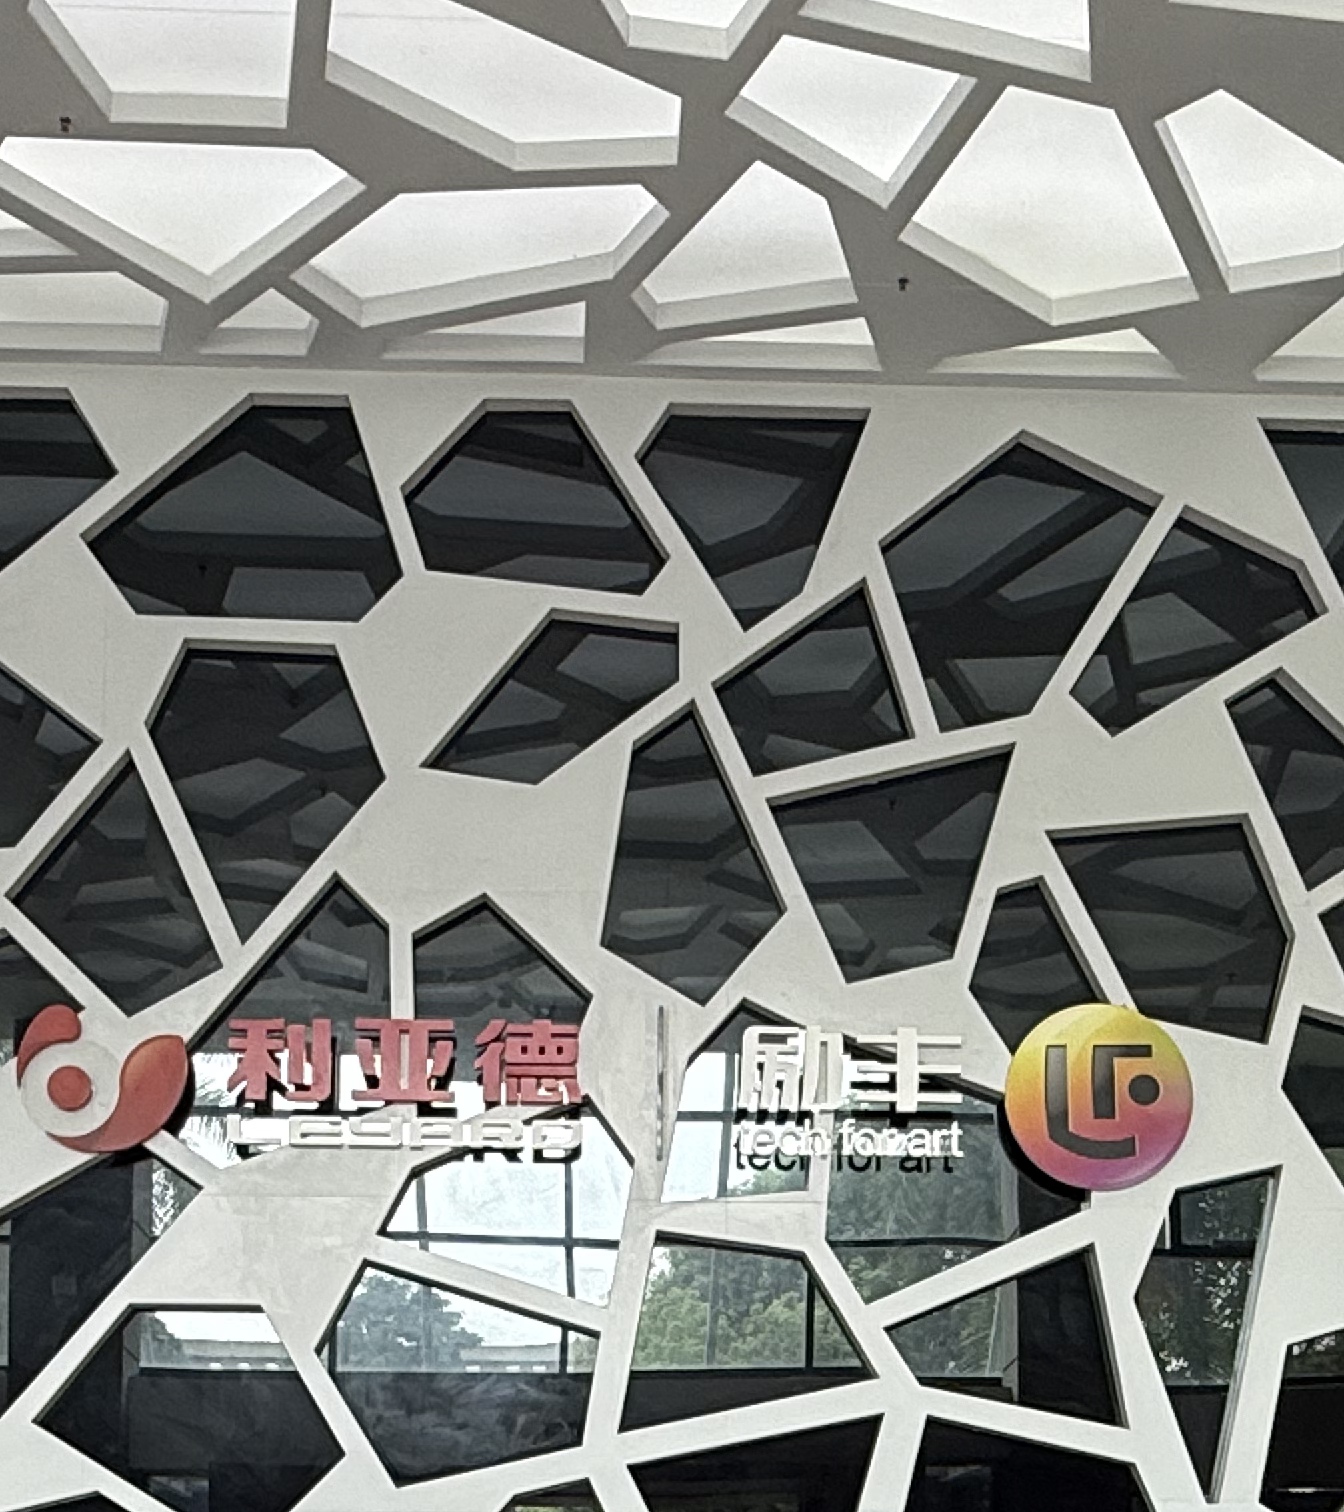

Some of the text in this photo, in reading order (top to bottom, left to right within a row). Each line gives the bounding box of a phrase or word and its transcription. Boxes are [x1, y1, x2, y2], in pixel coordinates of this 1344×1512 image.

[227, 1018, 582, 1105] 利亚德
[739, 1118, 965, 1157] tech for art
